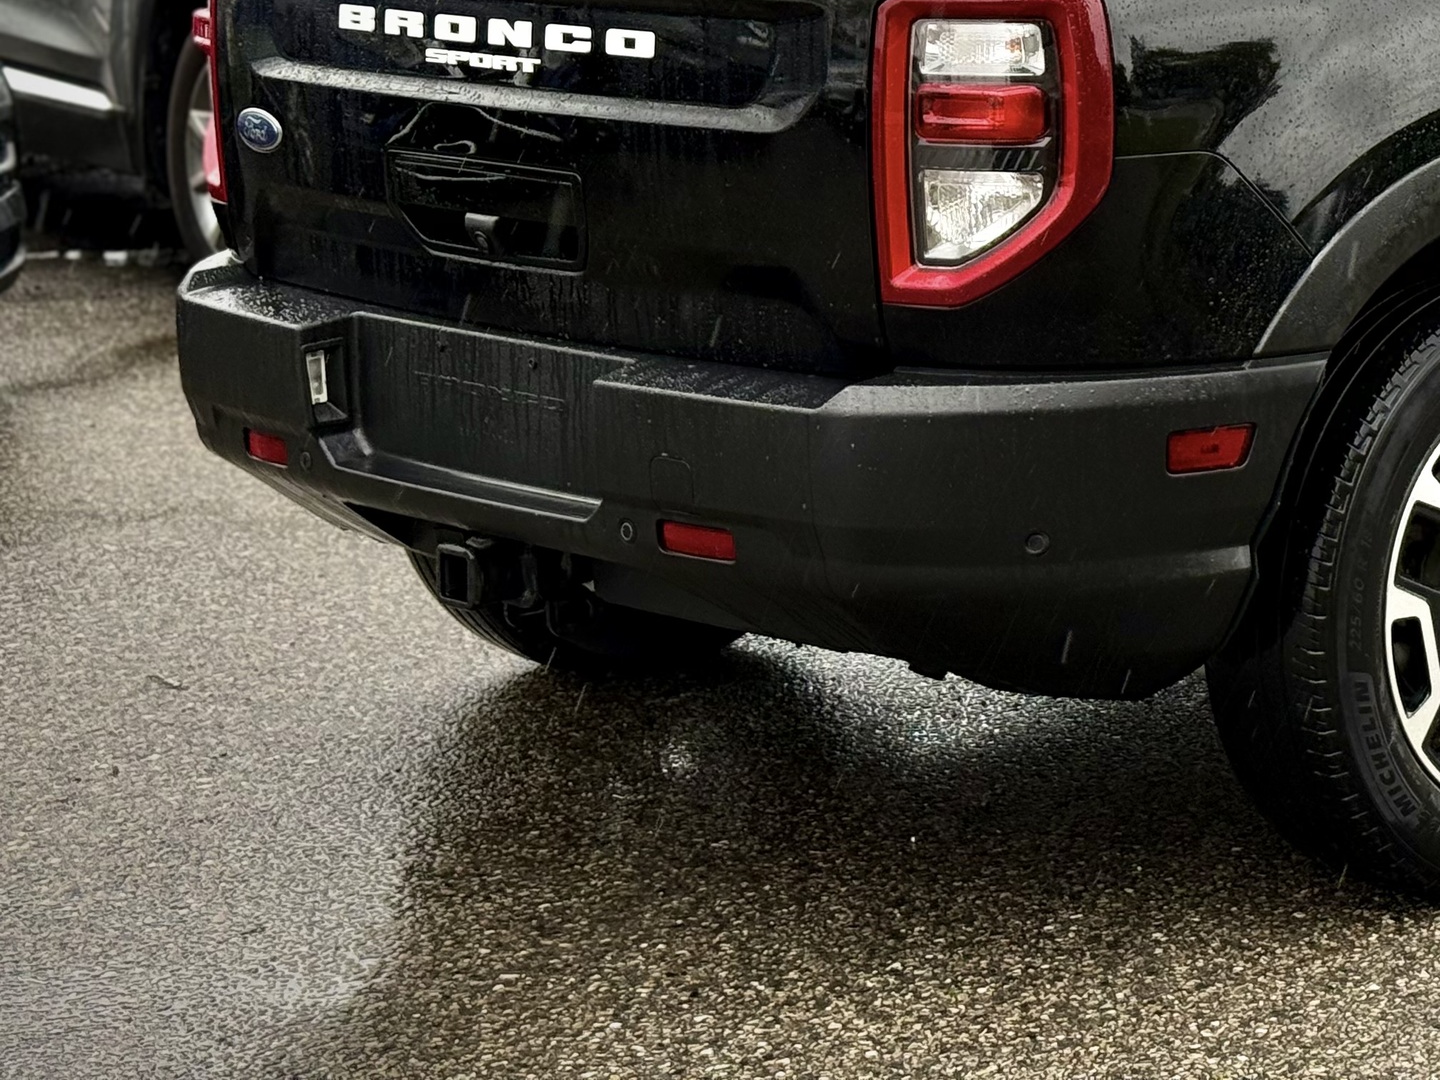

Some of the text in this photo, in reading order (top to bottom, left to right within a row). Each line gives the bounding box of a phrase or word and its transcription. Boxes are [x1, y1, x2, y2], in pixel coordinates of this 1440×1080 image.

[338, 3, 656, 59] BRONCO
[424, 47, 542, 73] SPORT
[1353, 681, 1417, 818] MICHELIN
